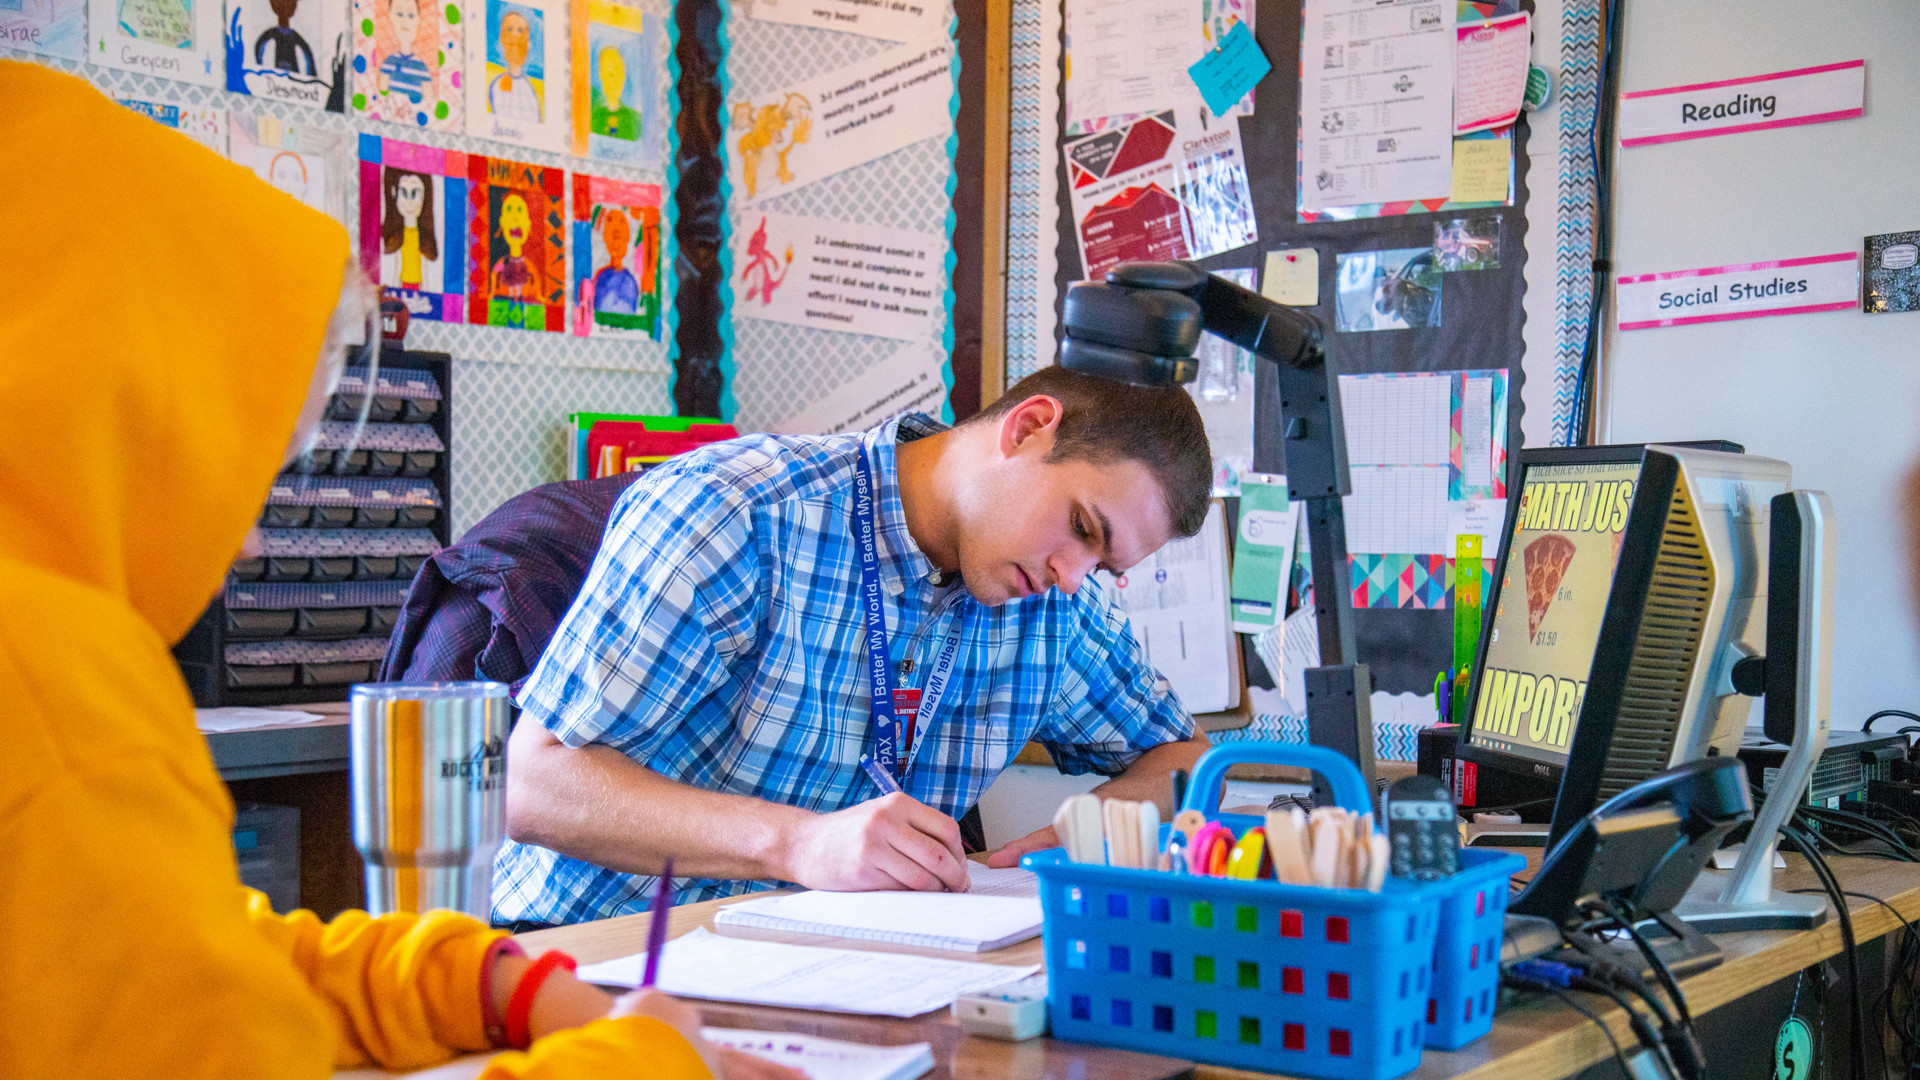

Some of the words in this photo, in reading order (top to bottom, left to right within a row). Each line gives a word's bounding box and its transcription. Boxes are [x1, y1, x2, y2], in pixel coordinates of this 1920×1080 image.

[882, 83, 899, 97] and
[1682, 94, 1777, 124] Reading
[829, 239, 883, 254] understand
[866, 262, 912, 277] complete
[842, 276, 857, 287] did
[859, 280, 875, 291] not
[893, 285, 907, 297] my
[1658, 285, 1719, 310] Social
[1728, 277, 1809, 301] Studies
[1523, 480, 1587, 532] MATH
[861, 519, 874, 563] Better
[866, 579, 880, 626] World,
[1557, 586, 1564, 601] 6
[870, 629, 885, 651] My
[1535, 631, 1558, 647] $1.50
[873, 653, 887, 697] Better
[879, 736, 894, 765] PAX
[1534, 763, 1550, 776] DELL
